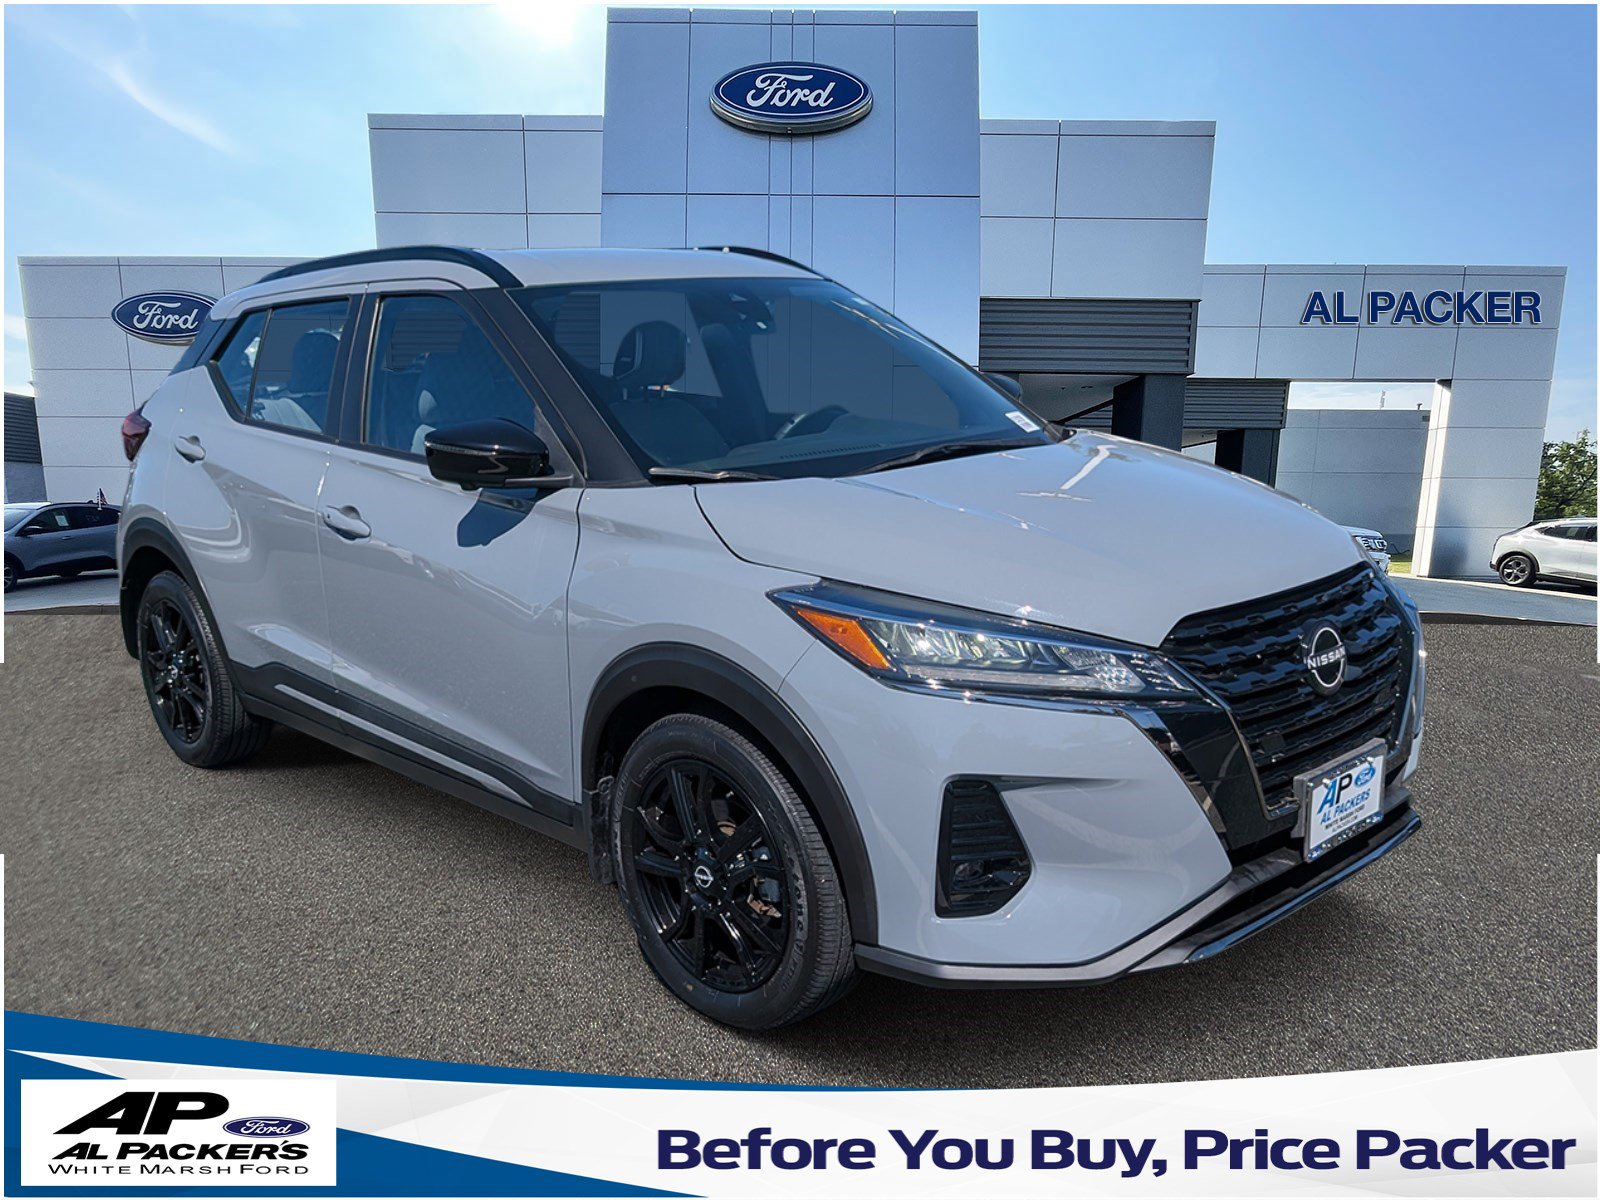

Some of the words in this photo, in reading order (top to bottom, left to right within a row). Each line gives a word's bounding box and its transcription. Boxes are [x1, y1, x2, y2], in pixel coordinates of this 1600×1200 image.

[746, 73, 836, 108] Ford
[133, 301, 199, 329] Ford
[1301, 289, 1360, 325] AL
[1368, 289, 1543, 325] PACKER
[1306, 645, 1346, 669] NISSAN
[1317, 771, 1353, 815] AP
